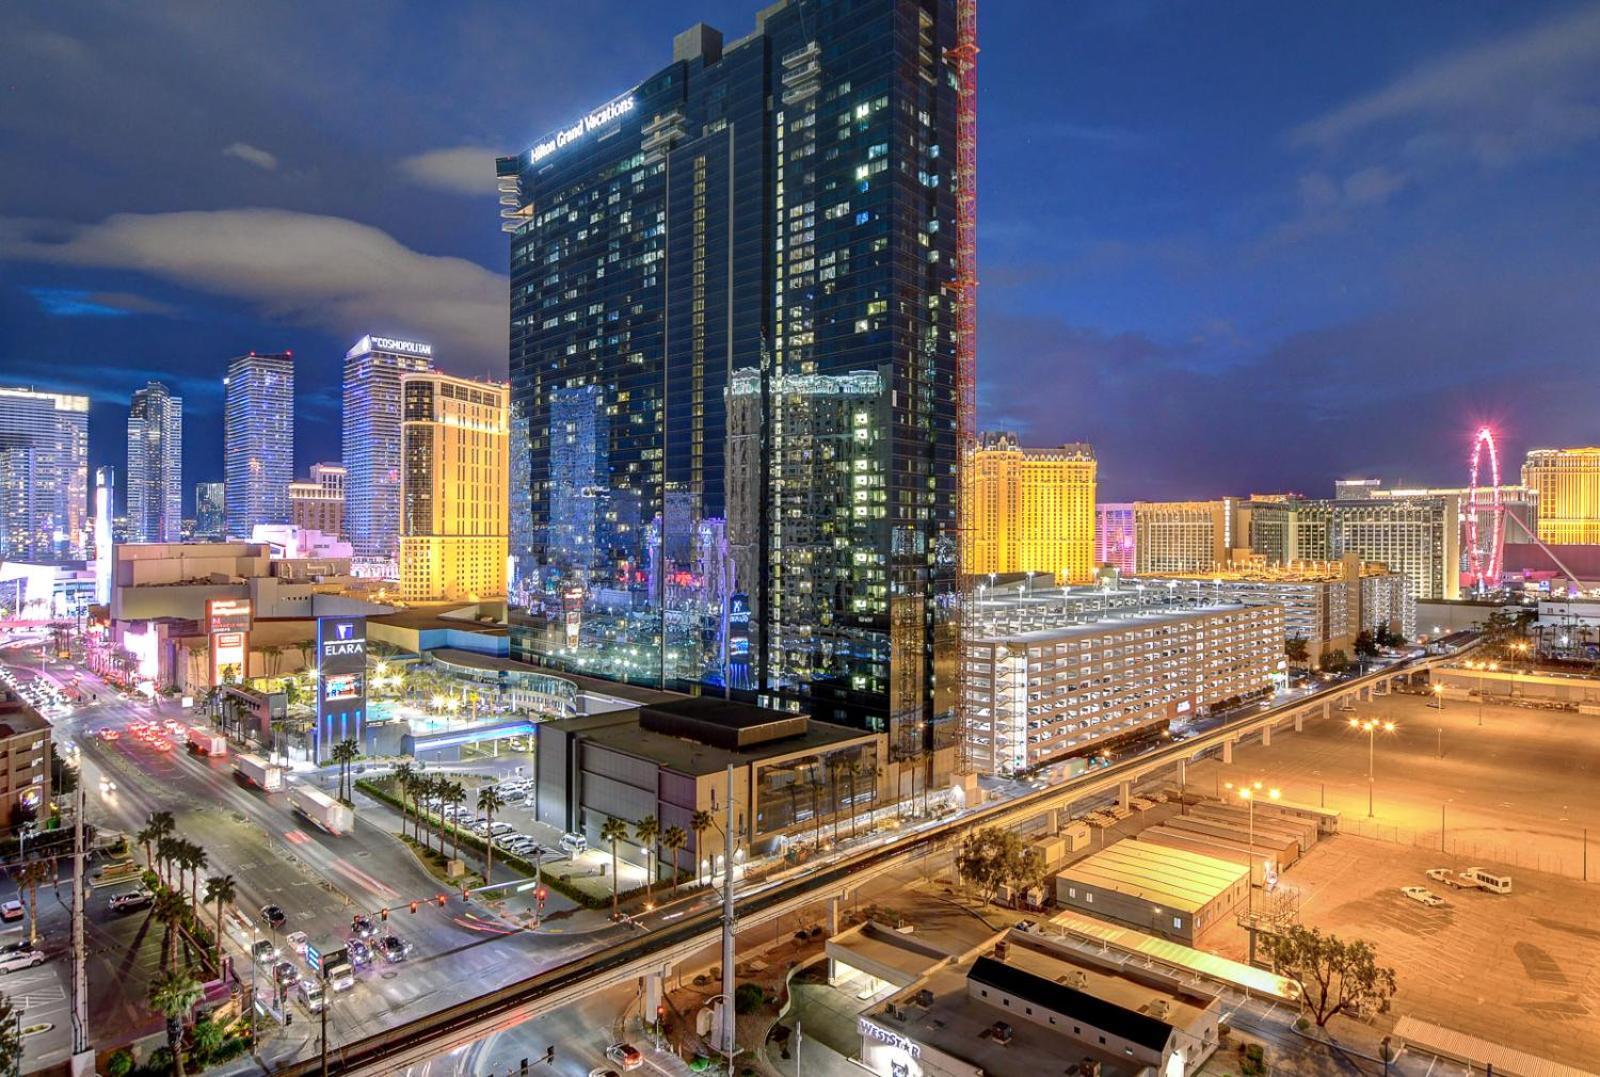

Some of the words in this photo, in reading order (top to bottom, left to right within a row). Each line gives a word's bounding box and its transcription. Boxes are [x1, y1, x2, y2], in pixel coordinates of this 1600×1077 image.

[530, 139, 557, 164] Hilton
[557, 118, 584, 148] Grand
[584, 96, 634, 131] Vacations
[377, 337, 432, 354] COSMOPOLITAN
[325, 643, 363, 656] ELARA
